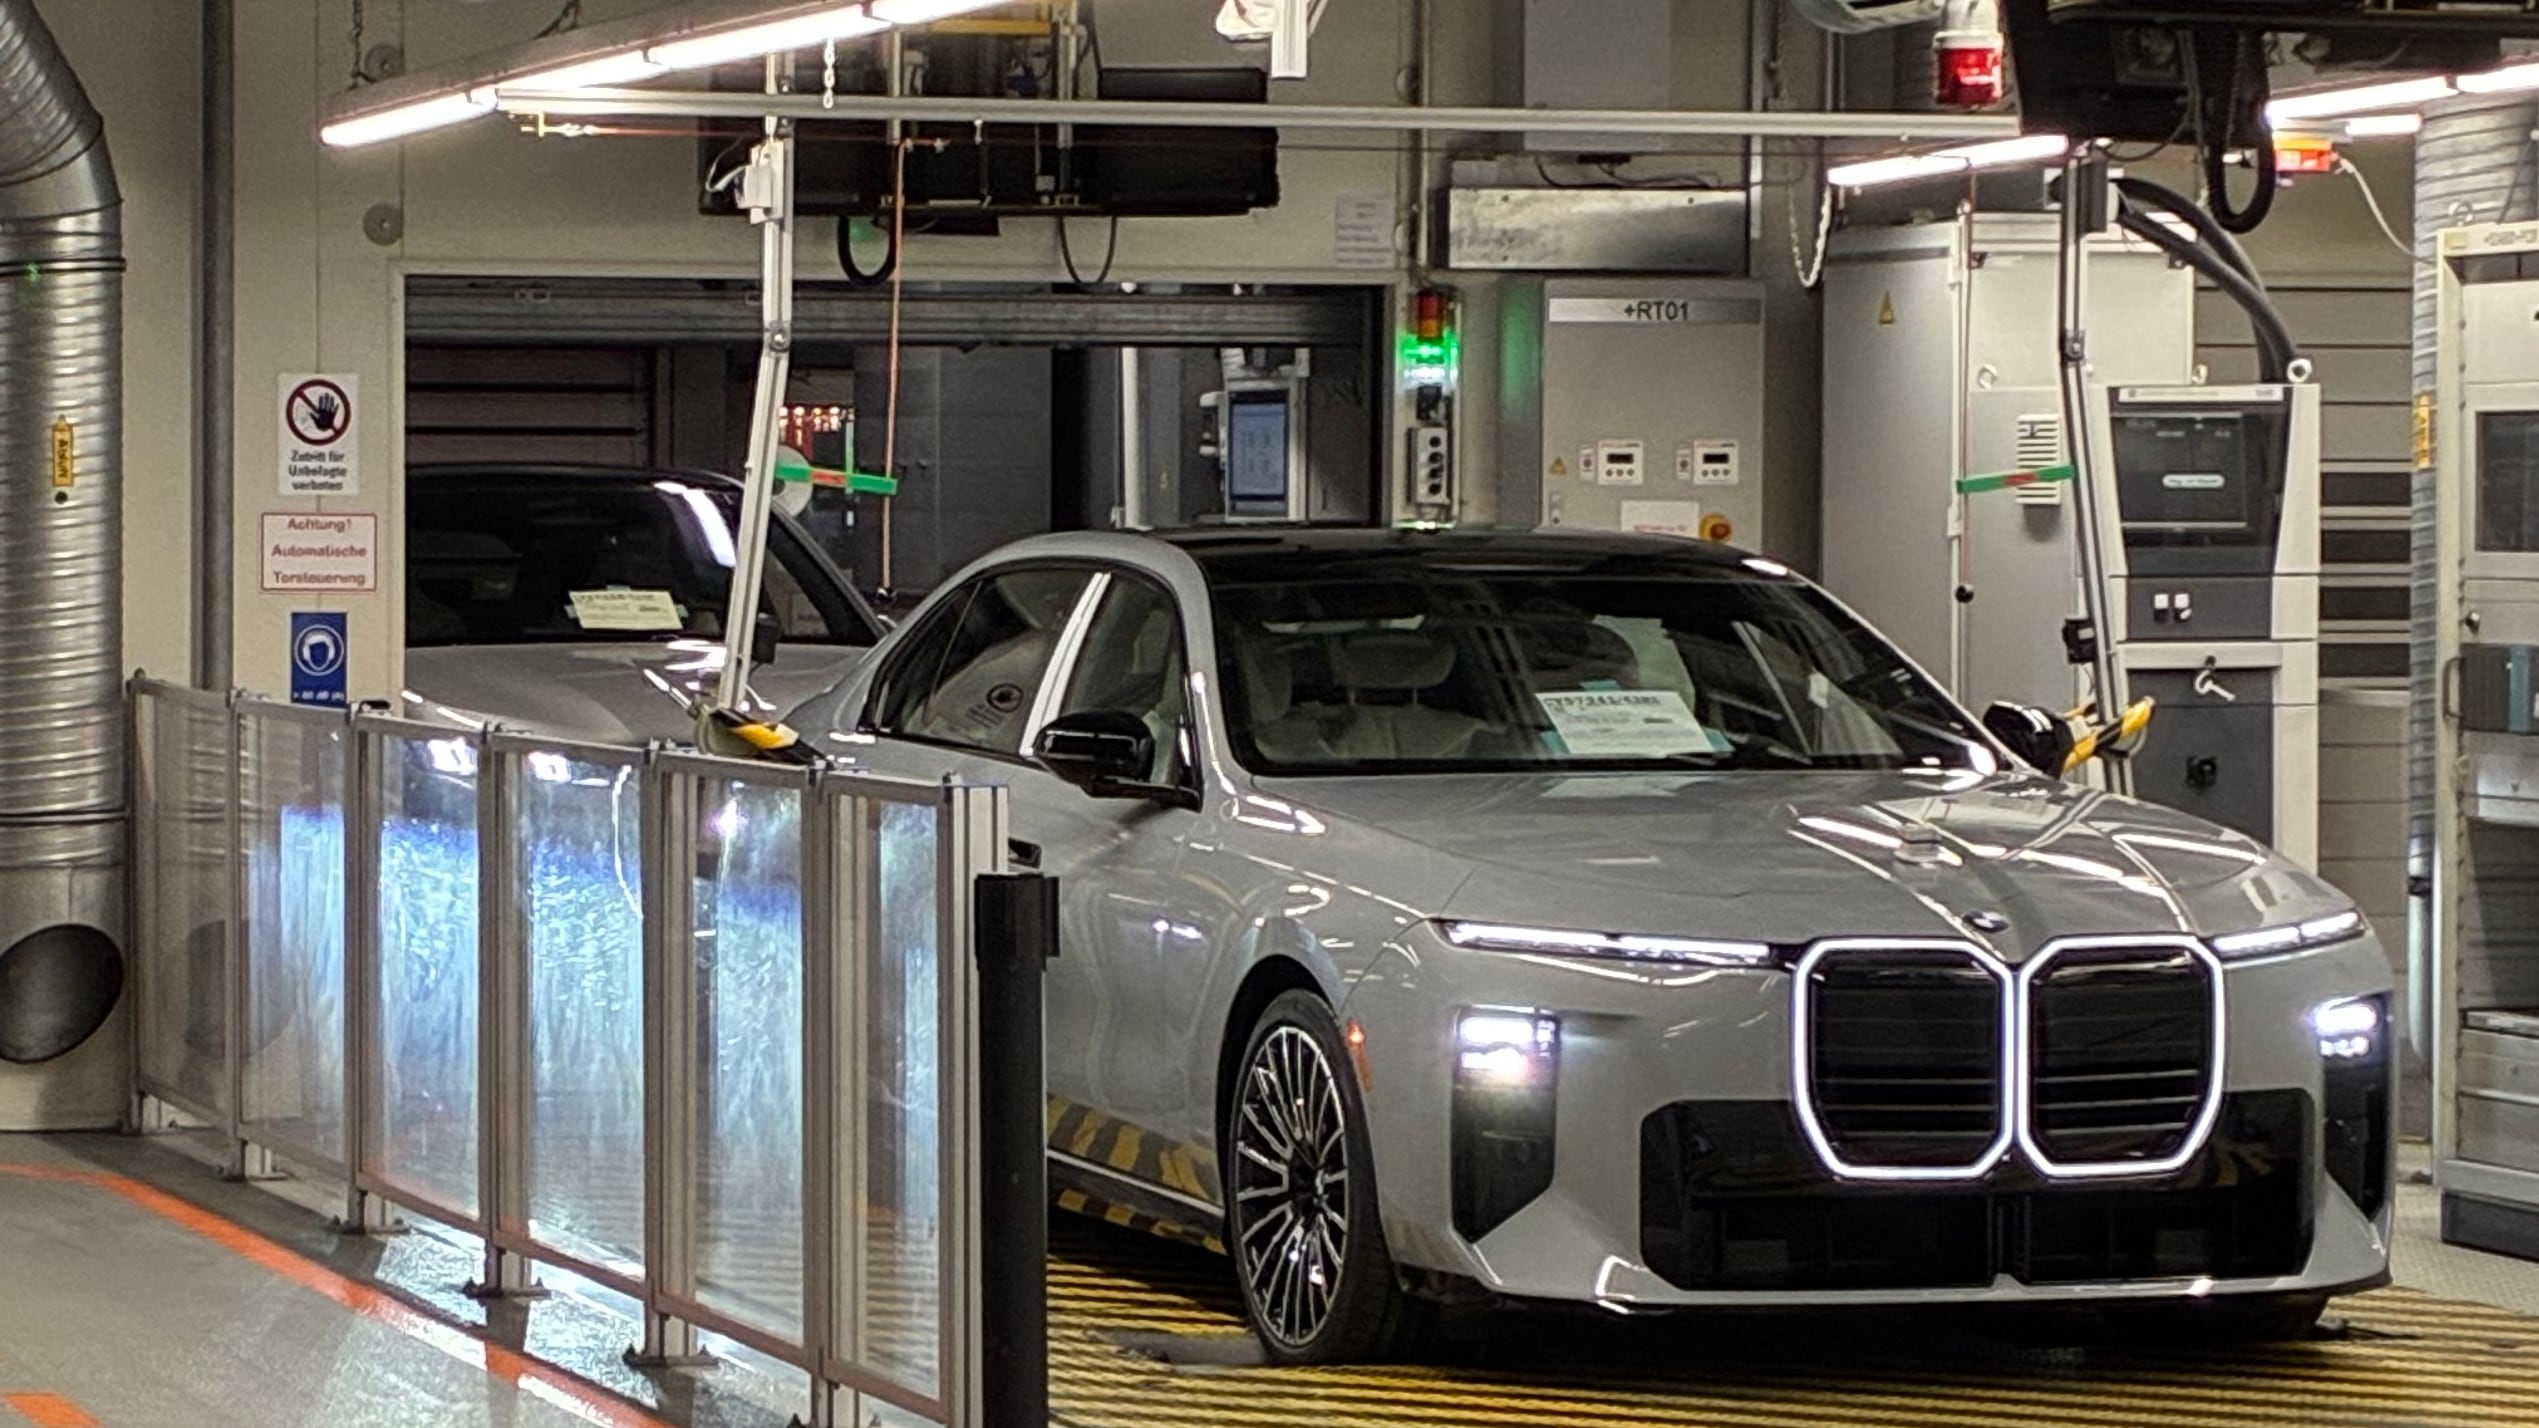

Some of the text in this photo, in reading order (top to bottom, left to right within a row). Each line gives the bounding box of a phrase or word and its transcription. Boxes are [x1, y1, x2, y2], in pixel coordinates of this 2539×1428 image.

[1624, 301, 1688, 320] +RT01
[291, 450, 345, 462] Zutritt für
[292, 480, 343, 490] verboten
[271, 544, 367, 557] Automatische
[273, 571, 366, 586] Torsteuerung
